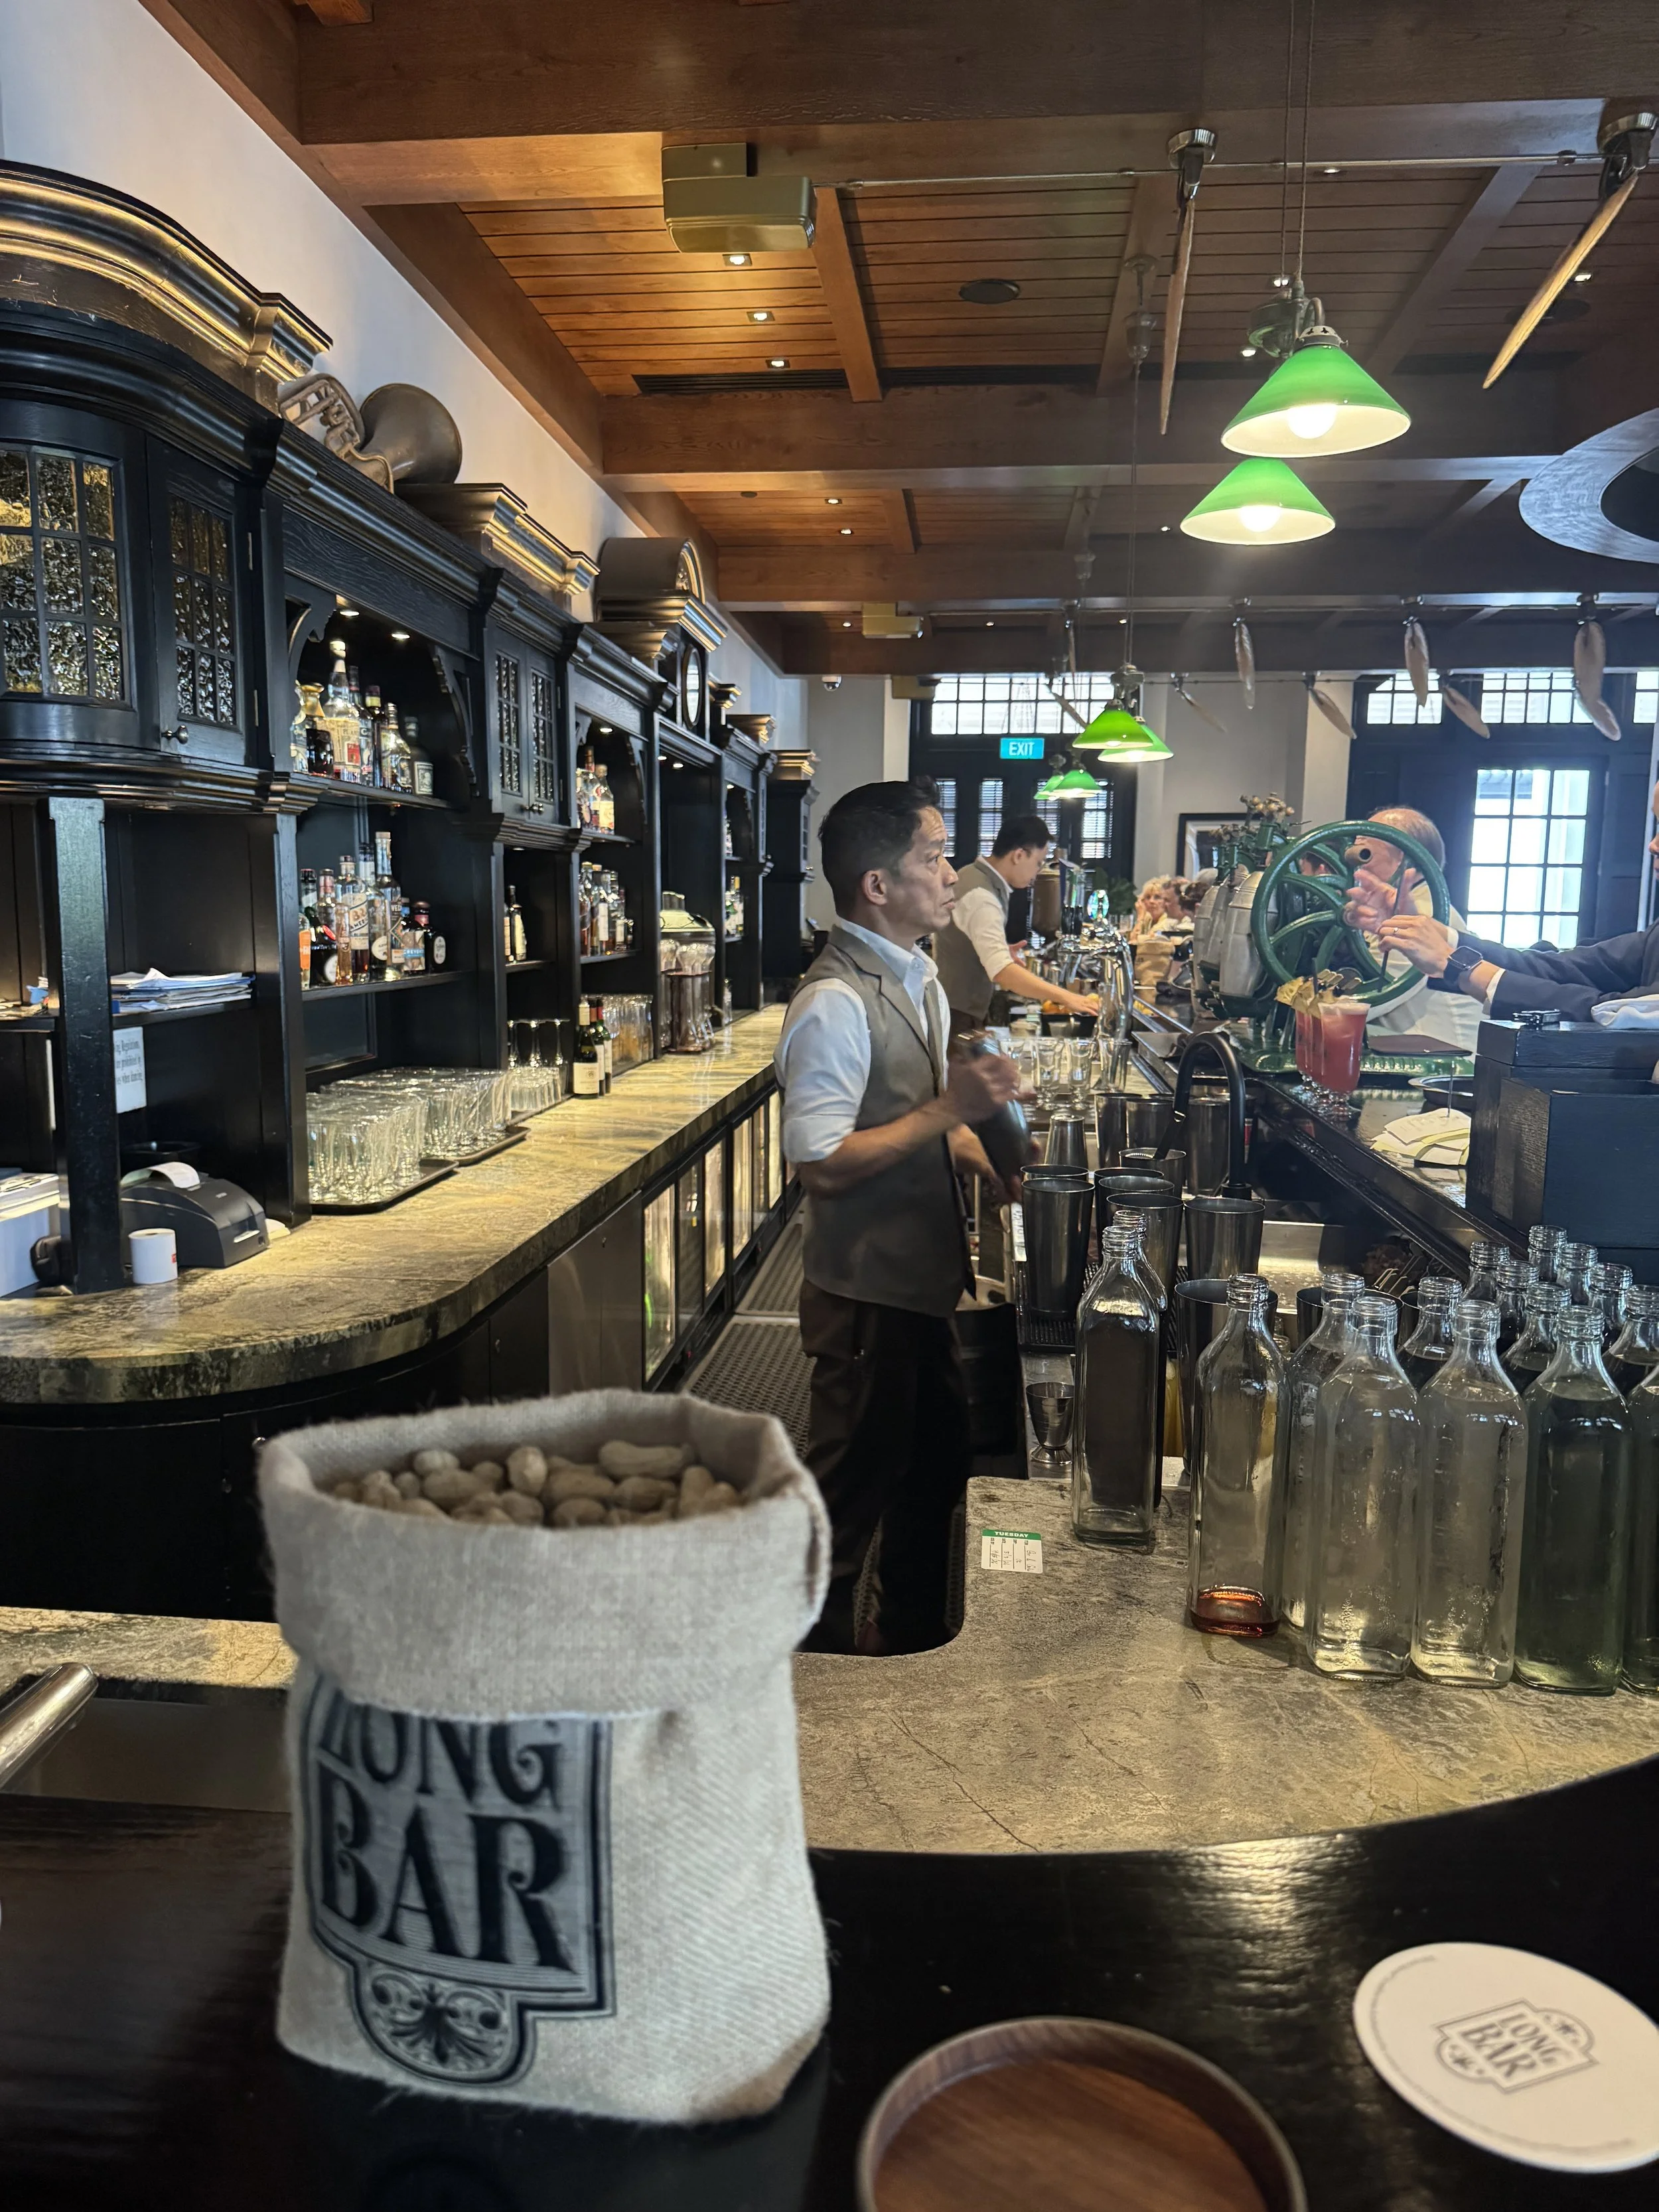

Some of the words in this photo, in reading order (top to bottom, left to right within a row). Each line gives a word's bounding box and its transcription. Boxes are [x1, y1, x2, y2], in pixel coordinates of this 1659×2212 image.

[1009, 742, 1035, 756] EXIT
[319, 1760, 580, 1975] BAR
[1461, 2022, 1538, 2078] BAR
[1498, 2013, 1574, 2064] LONG
